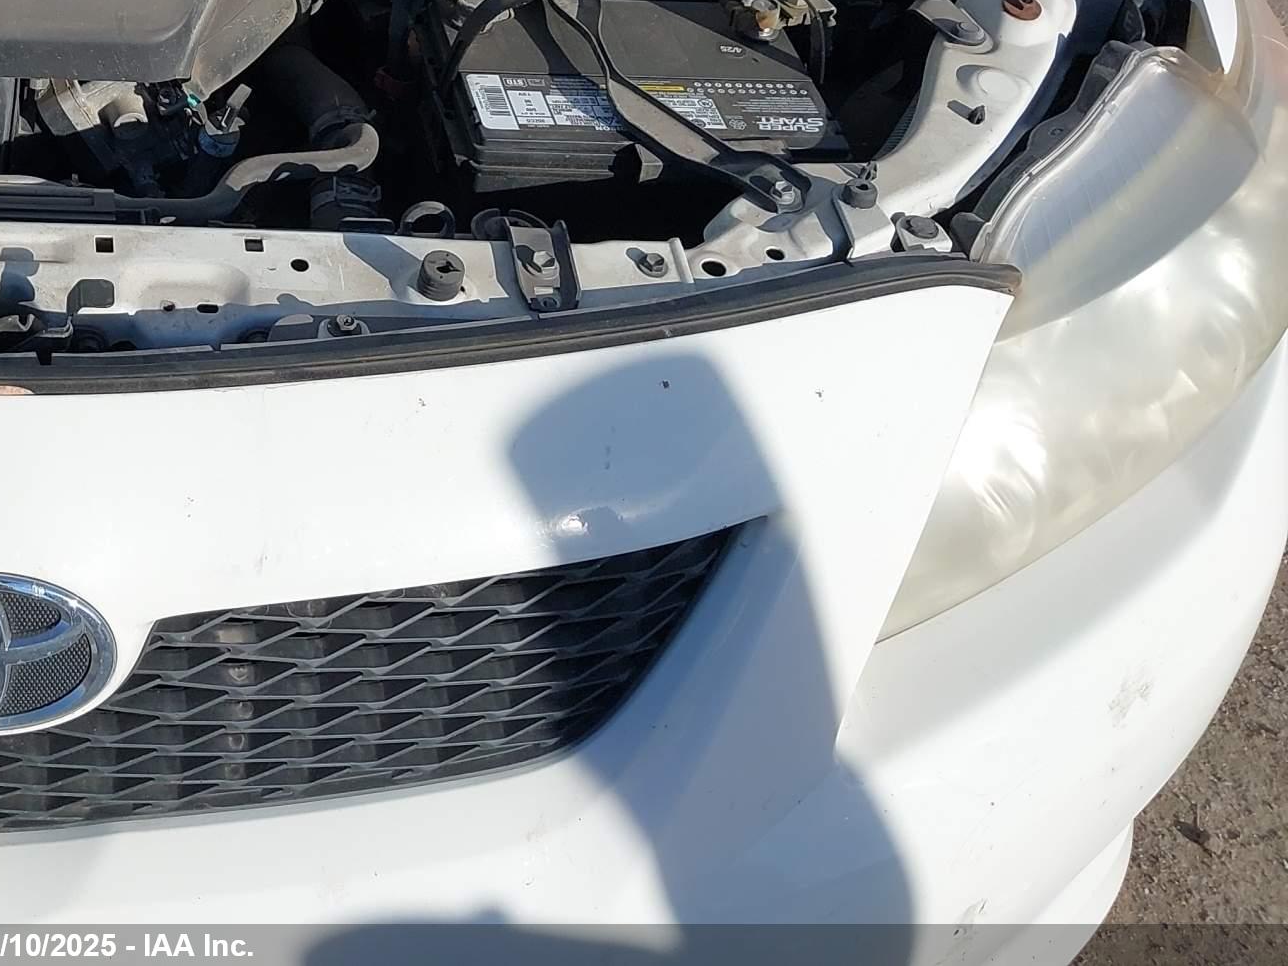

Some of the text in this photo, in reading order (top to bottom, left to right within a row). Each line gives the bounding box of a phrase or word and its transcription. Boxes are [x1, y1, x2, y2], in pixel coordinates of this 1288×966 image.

[719, 45, 743, 54] 4/25
[756, 117, 824, 127] START
[758, 123, 820, 133] SUPER
